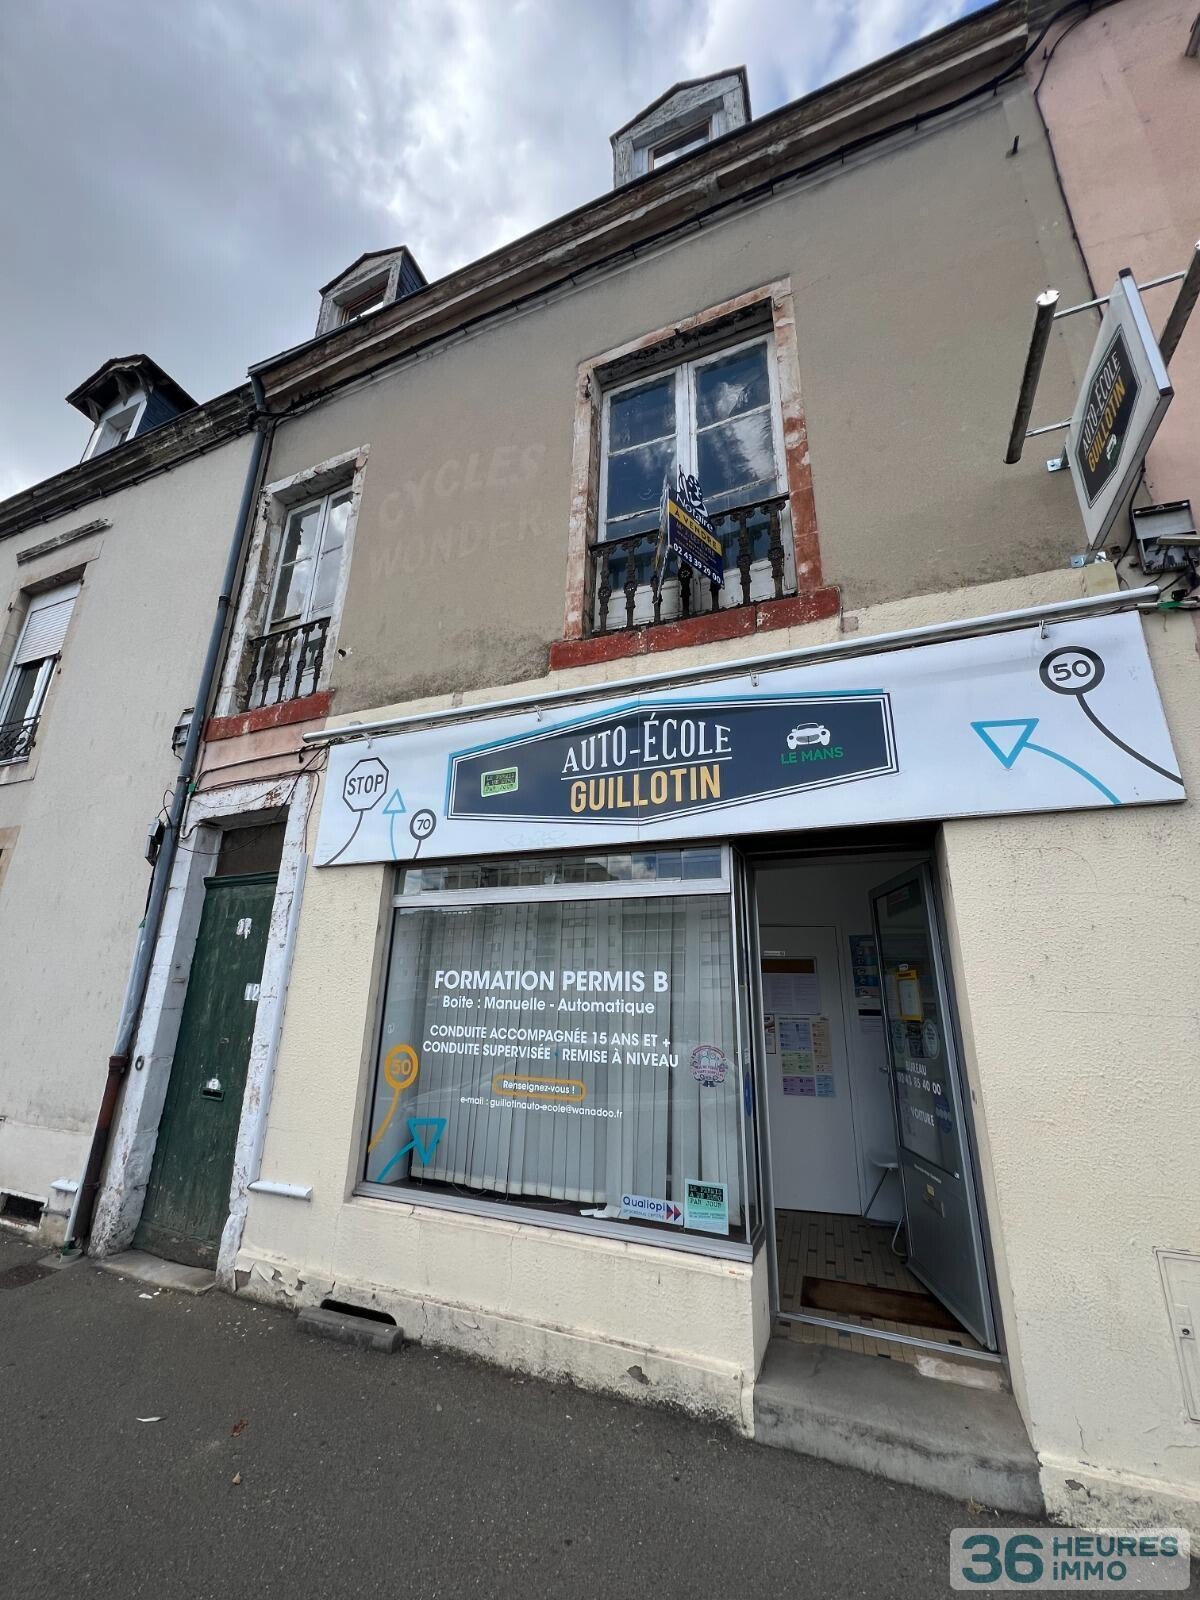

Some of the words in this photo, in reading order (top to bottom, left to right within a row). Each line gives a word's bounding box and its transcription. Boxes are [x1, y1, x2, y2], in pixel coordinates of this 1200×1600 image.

[1088, 375, 1126, 473] GUILLOTIN
[379, 442, 547, 529] CYCLES
[682, 516, 717, 550] VENDRE
[673, 543, 683, 555] 02
[1053, 660, 1091, 681] 50
[561, 712, 732, 773] AUTO-ÉCOLE
[780, 752, 798, 765] LE
[801, 746, 844, 762] MANS
[347, 774, 384, 795] STOP
[570, 764, 721, 813] GUILLOTIN
[417, 818, 431, 831] 70
[434, 970, 554, 991] FORMATION
[562, 970, 645, 992] PERMIS
[653, 971, 669, 992] B
[484, 996, 546, 1010] Manuelle
[557, 998, 655, 1017] Automatique
[430, 1024, 487, 1039] CONDUITE
[489, 1027, 588, 1044] ACCOMPAGNÉE
[592, 1031, 607, 1045] 15
[611, 1032, 640, 1046] ANS
[643, 1033, 658, 1047] ET
[662, 1038, 670, 1048] +
[422, 1040, 480, 1055] CONDUITE
[482, 1043, 551, 1060] SUPERVISÉE
[562, 1048, 608, 1064] REMISE
[611, 1047, 622, 1064] À
[626, 1051, 679, 1068] NIVEAU
[503, 1080, 570, 1094] Renseignez-vous
[922, 1079, 931, 1092] 40
[932, 1082, 942, 1096] 00
[460, 1096, 484, 1105] e-mail
[623, 1196, 665, 1213] Qualiopi
